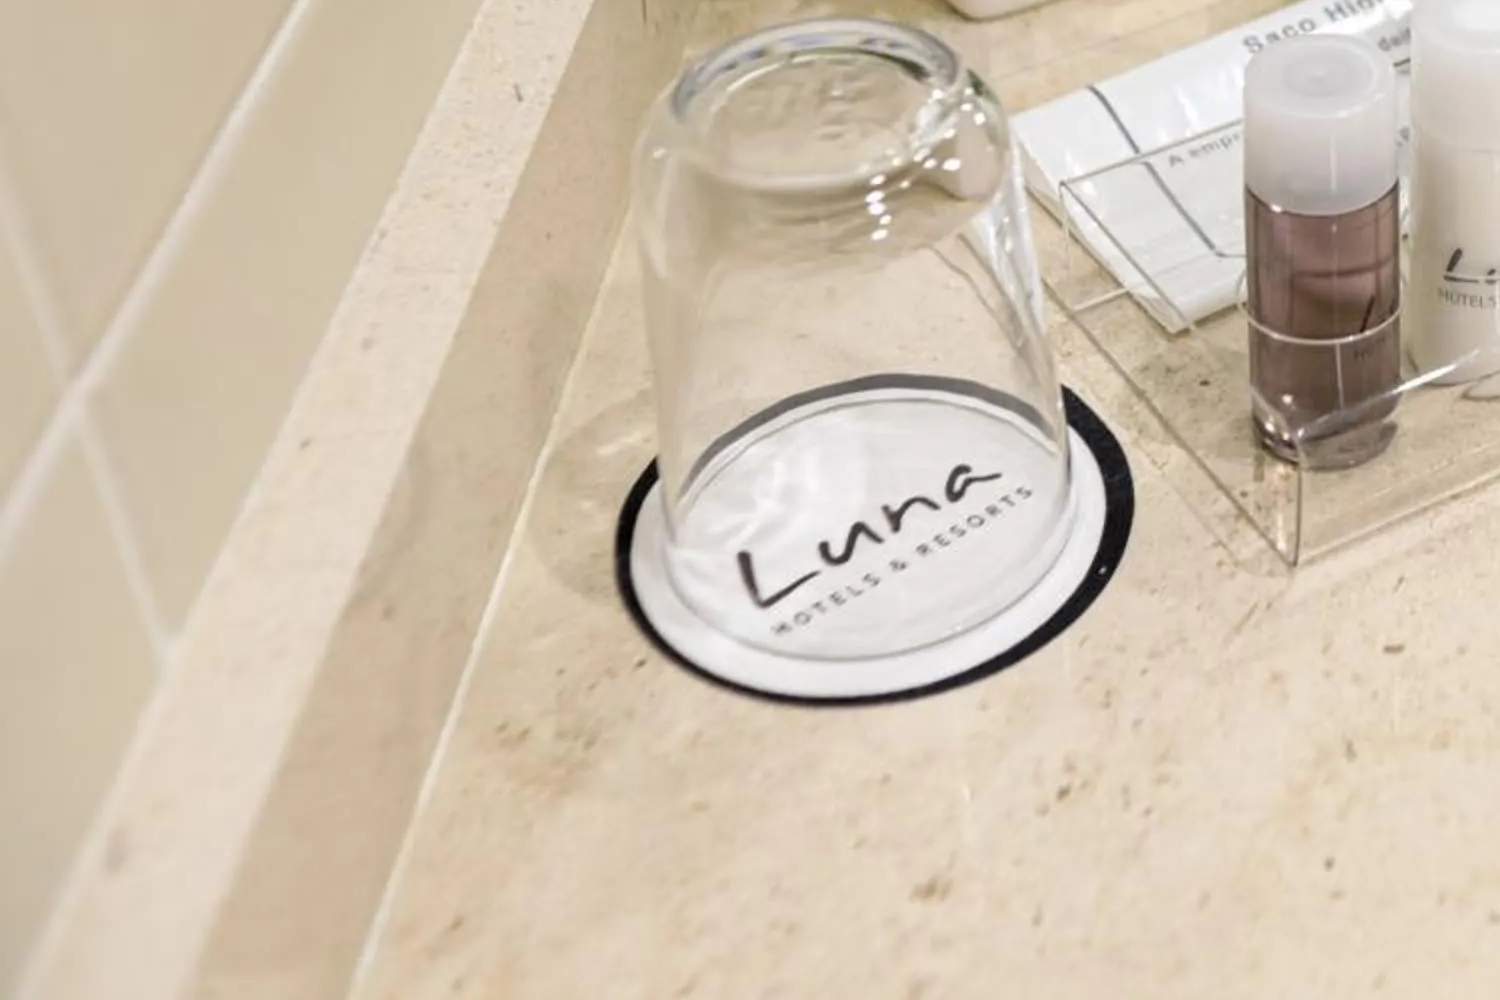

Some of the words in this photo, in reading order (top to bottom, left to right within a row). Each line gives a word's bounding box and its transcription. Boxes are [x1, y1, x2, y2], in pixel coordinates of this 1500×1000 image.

[1242, 16, 1317, 53] Saco
[737, 463, 1002, 610] Luna
[770, 571, 881, 638] HOTELS
[915, 485, 1034, 557] RESORTS
